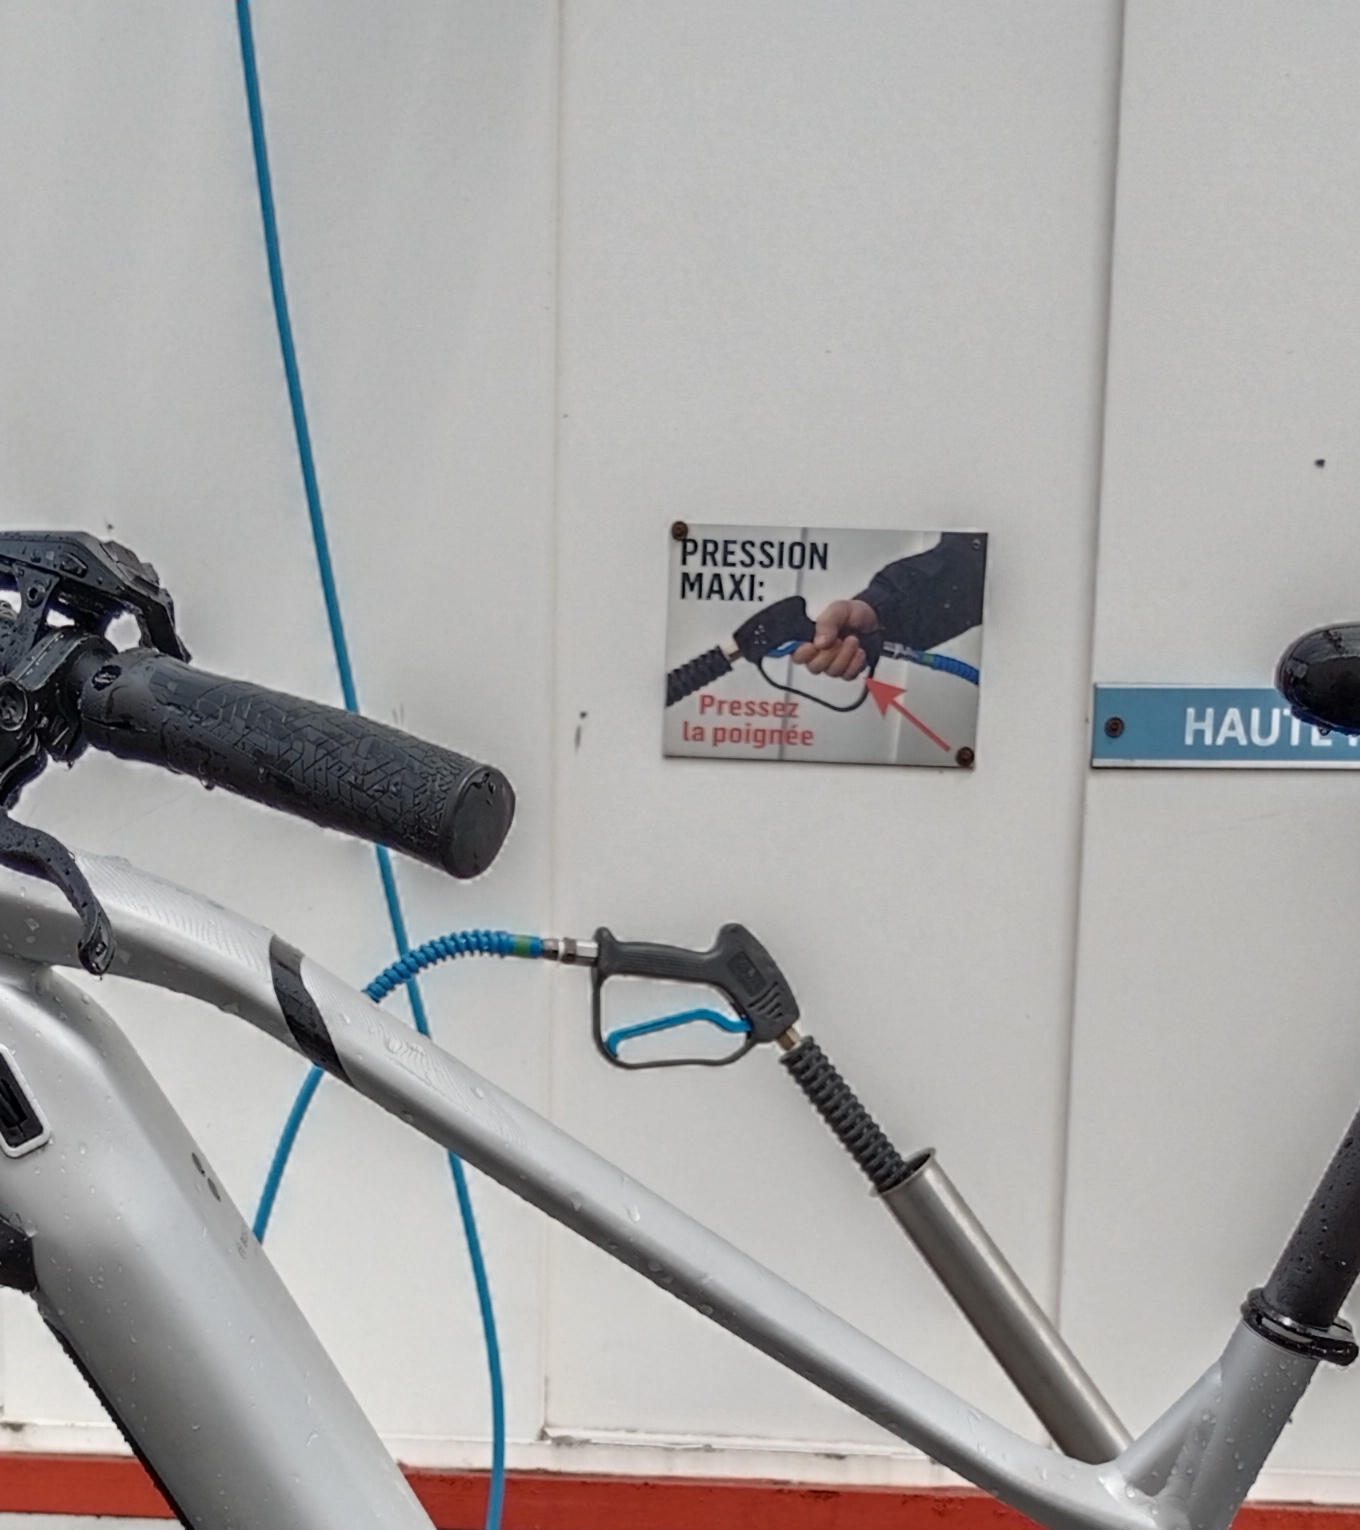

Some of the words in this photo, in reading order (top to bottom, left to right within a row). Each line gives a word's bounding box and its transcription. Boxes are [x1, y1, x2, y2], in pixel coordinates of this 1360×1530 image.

[681, 539, 828, 570] PRESSION
[681, 572, 765, 602] MAXI:
[699, 694, 799, 718] Pressez
[682, 721, 706, 742] la
[712, 724, 814, 749] poignée
